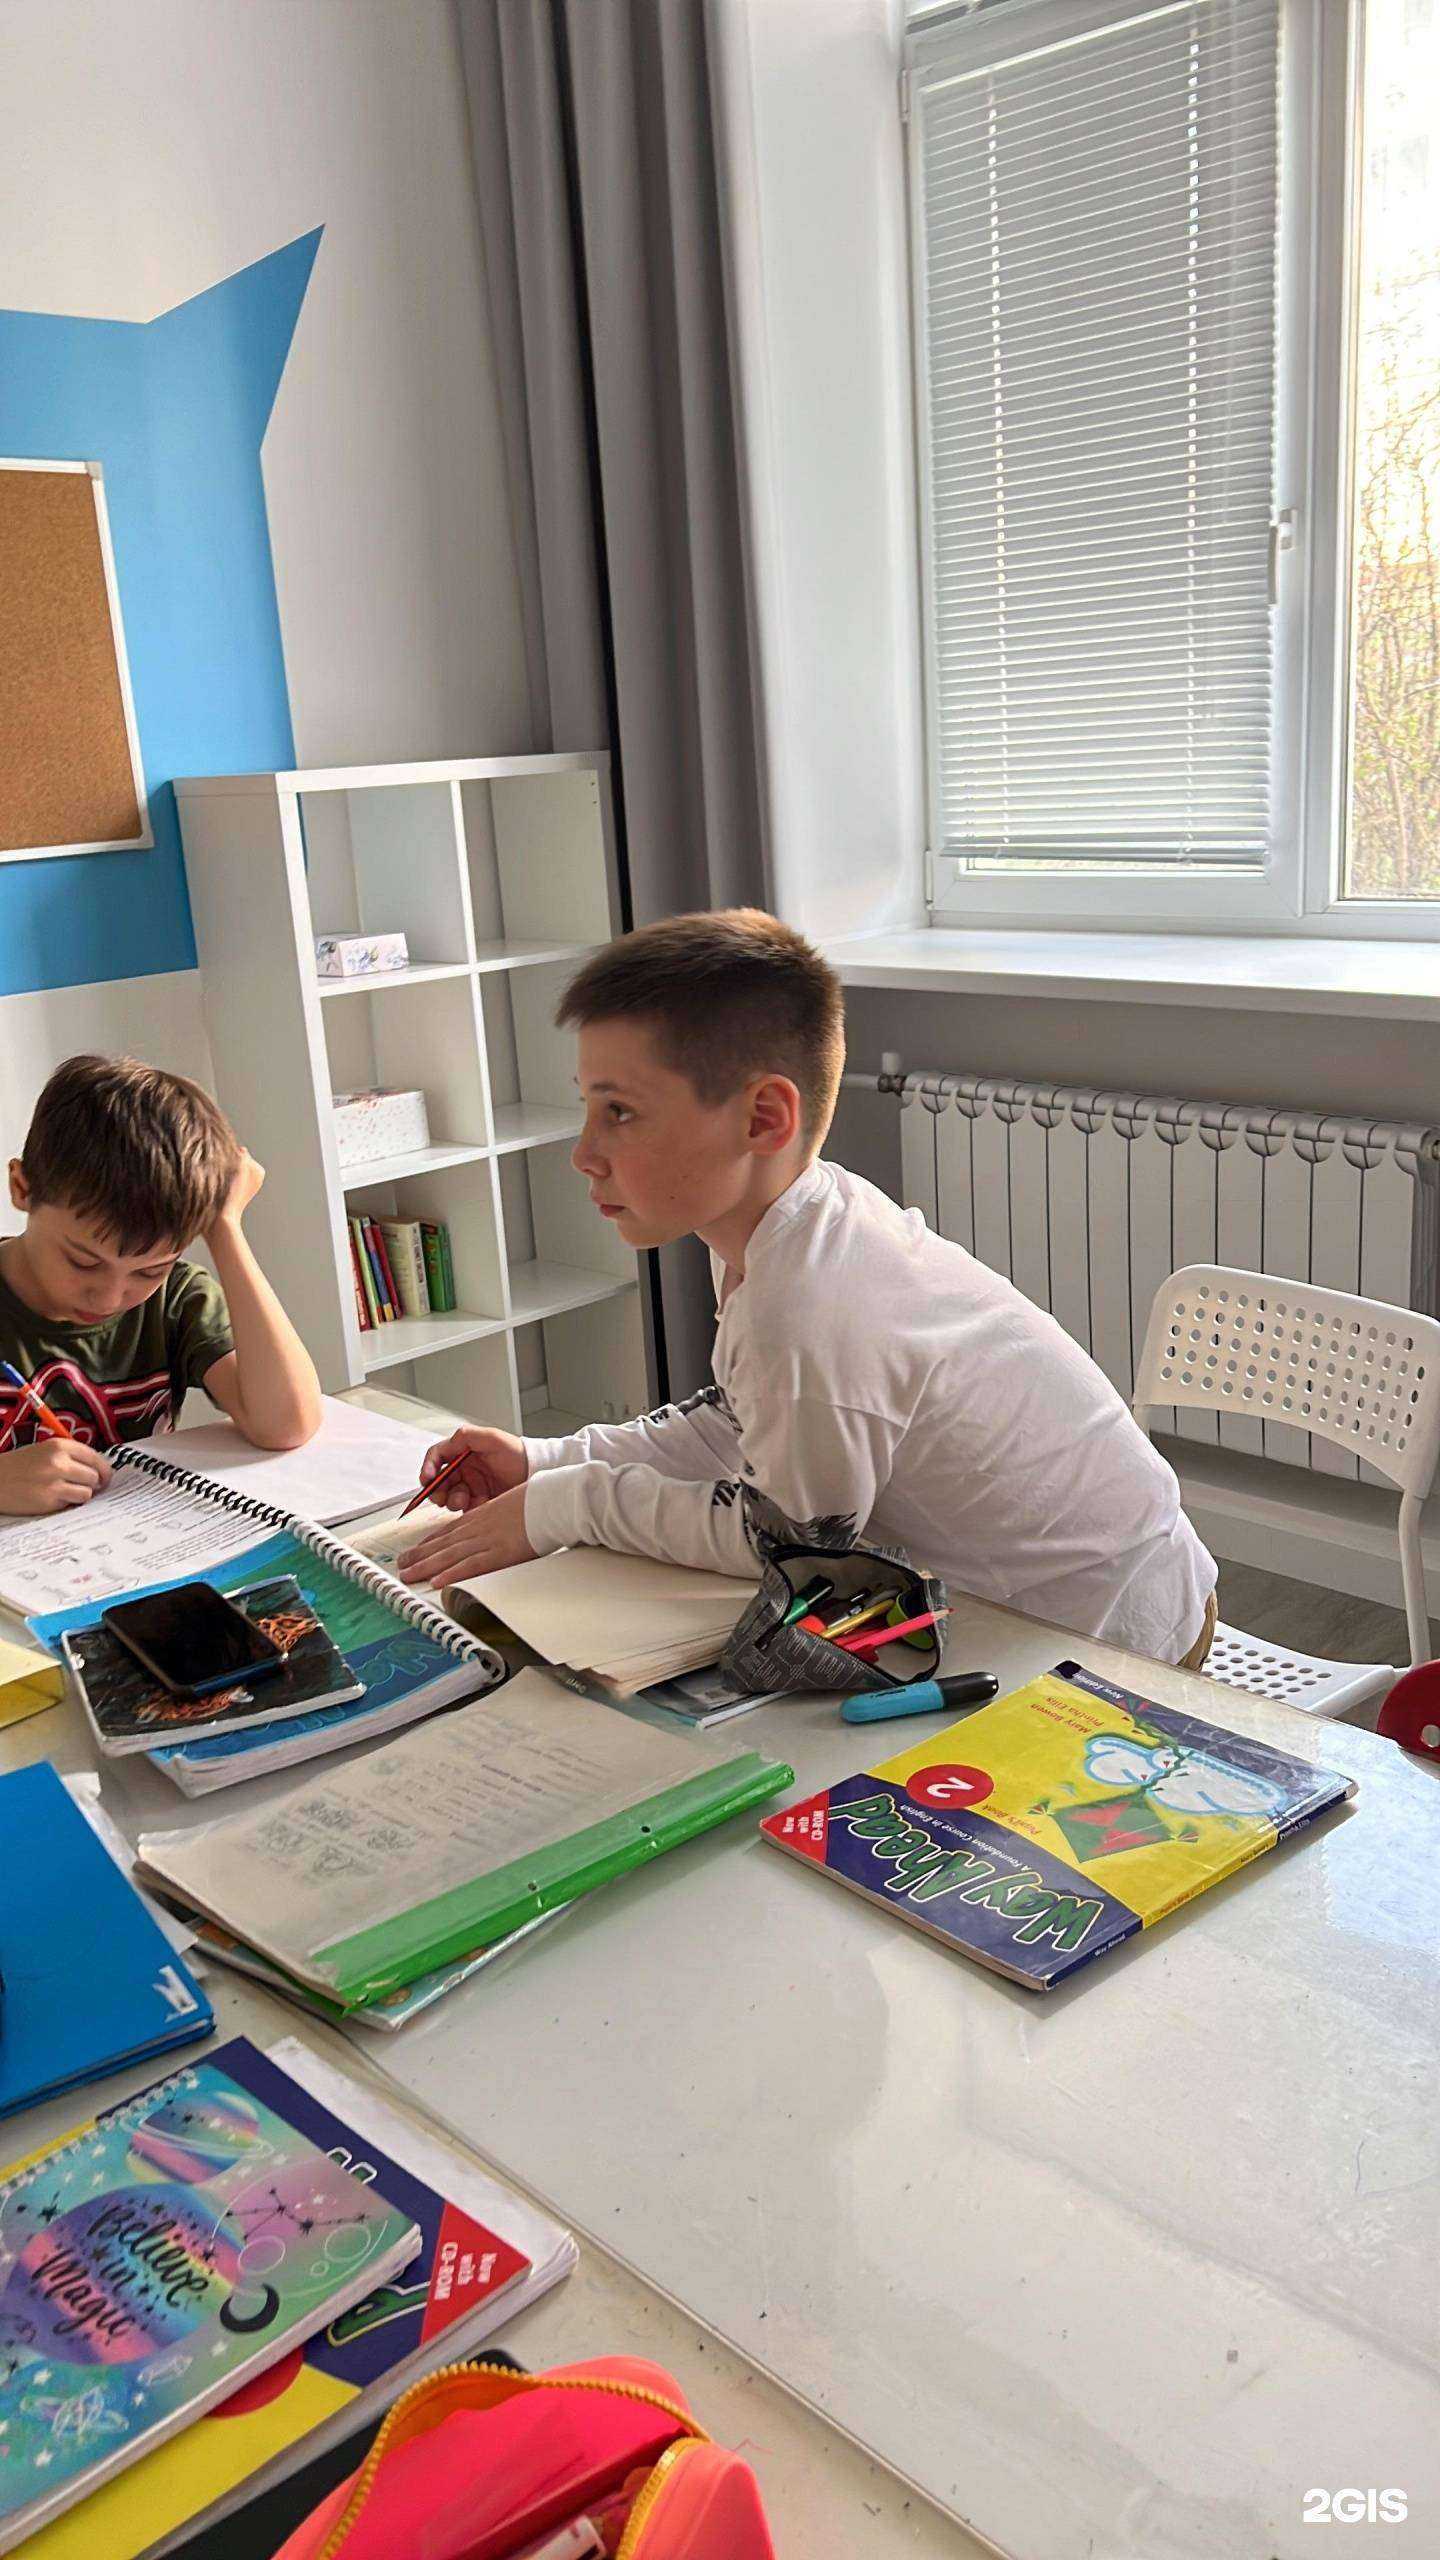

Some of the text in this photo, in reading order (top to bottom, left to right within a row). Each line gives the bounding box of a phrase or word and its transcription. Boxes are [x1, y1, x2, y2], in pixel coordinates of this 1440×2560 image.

[1102, 1687, 1125, 1699] New
[1031, 1703, 1092, 1734] Mary Bowen
[926, 1776, 975, 1799] 2
[782, 1816, 795, 1833] New
[798, 1815, 810, 1834] with
[811, 1809, 825, 1841] CD-ROM
[981, 1804, 1043, 1836] Pupil's Book
[900, 1803, 1032, 1872] A Foundation Course in English
[828, 1792, 1104, 1953] Way Ahead
[86, 2204, 209, 2308] Believe
[433, 2241, 459, 2301] CD-ROM
[456, 2252, 476, 2287] with
[476, 2251, 498, 2284] New
[31, 2248, 136, 2337] Magic
[99, 2256, 138, 2296] in
